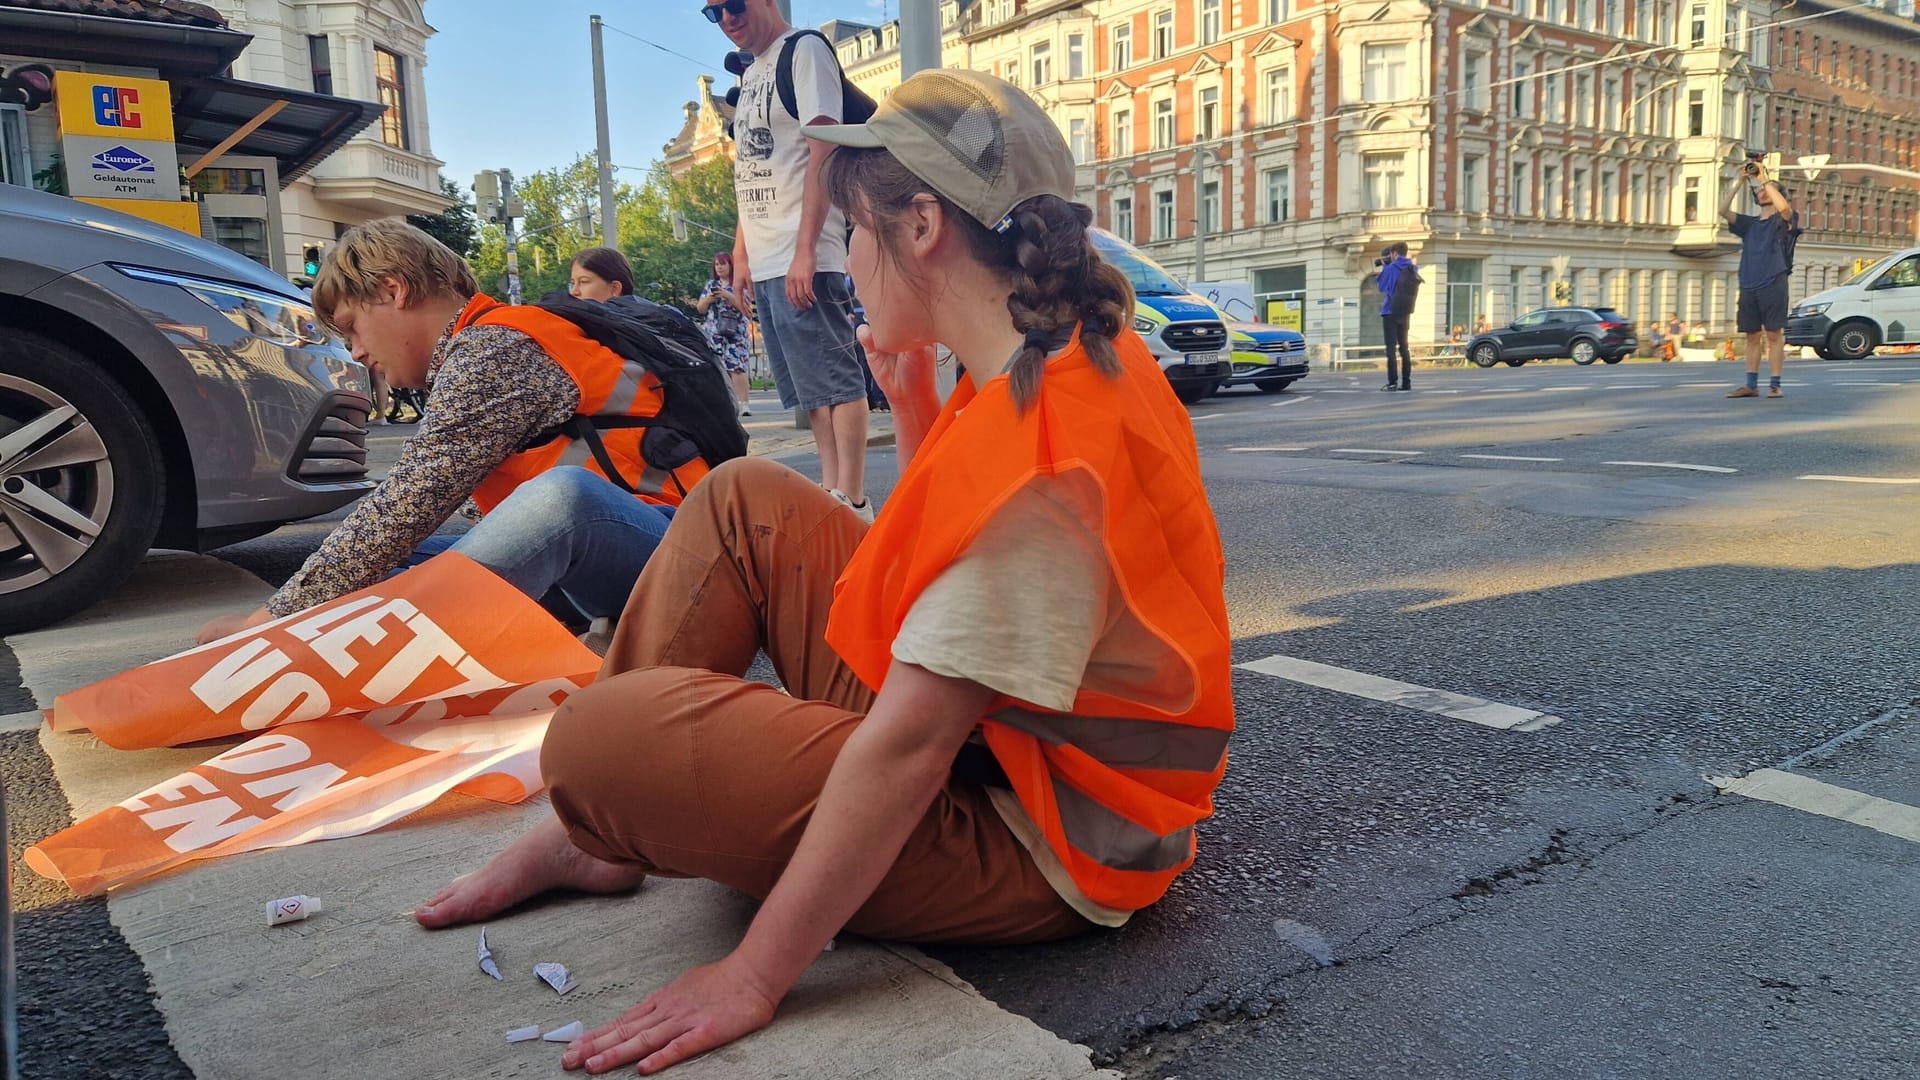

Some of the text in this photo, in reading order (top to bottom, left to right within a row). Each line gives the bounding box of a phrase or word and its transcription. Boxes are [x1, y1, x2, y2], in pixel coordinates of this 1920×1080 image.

[103, 153, 142, 164] Euronet
[94, 174, 155, 184] Geldautomat
[115, 185, 137, 193] ATM
